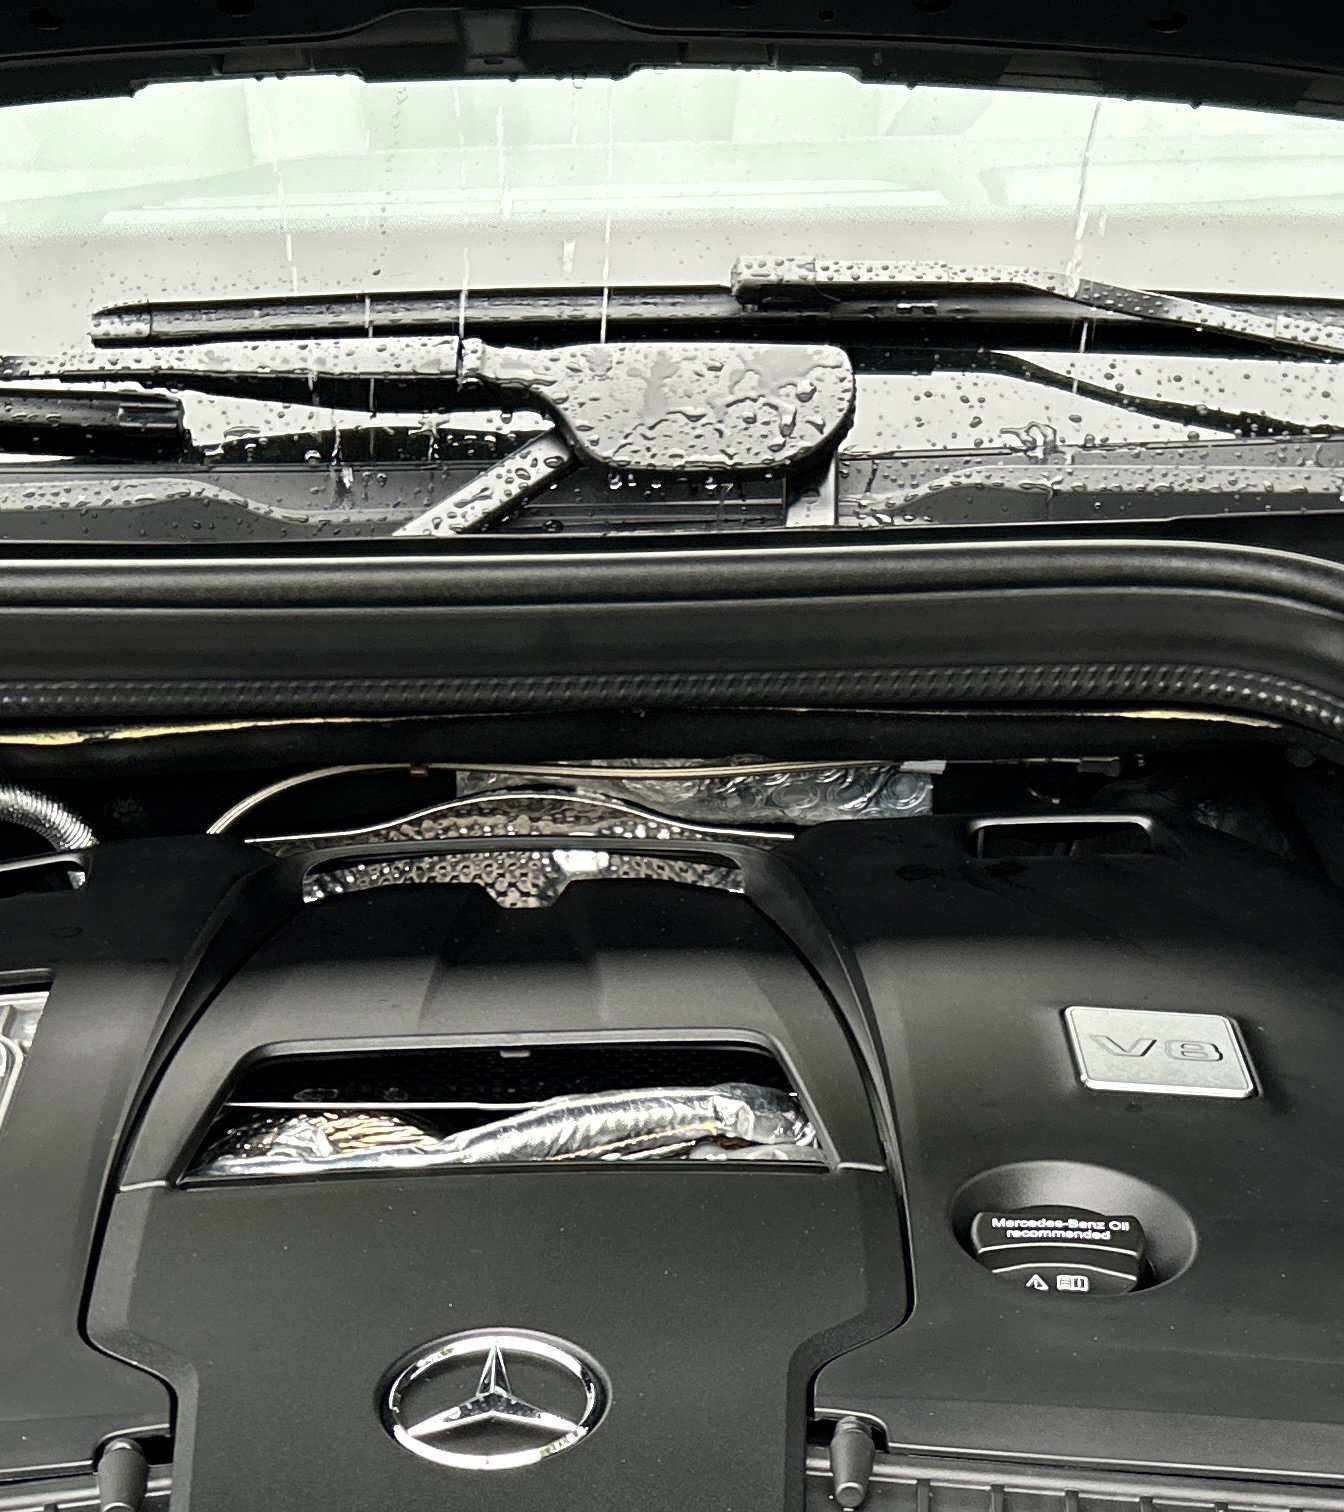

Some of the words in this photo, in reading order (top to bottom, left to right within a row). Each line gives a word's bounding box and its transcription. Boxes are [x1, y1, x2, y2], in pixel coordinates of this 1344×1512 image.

[1089, 1034, 1224, 1062] V8
[991, 1217, 1106, 1231] Mercedes-Benz
[1109, 1220, 1131, 1232] Oil
[1005, 1228, 1111, 1241] recommended
